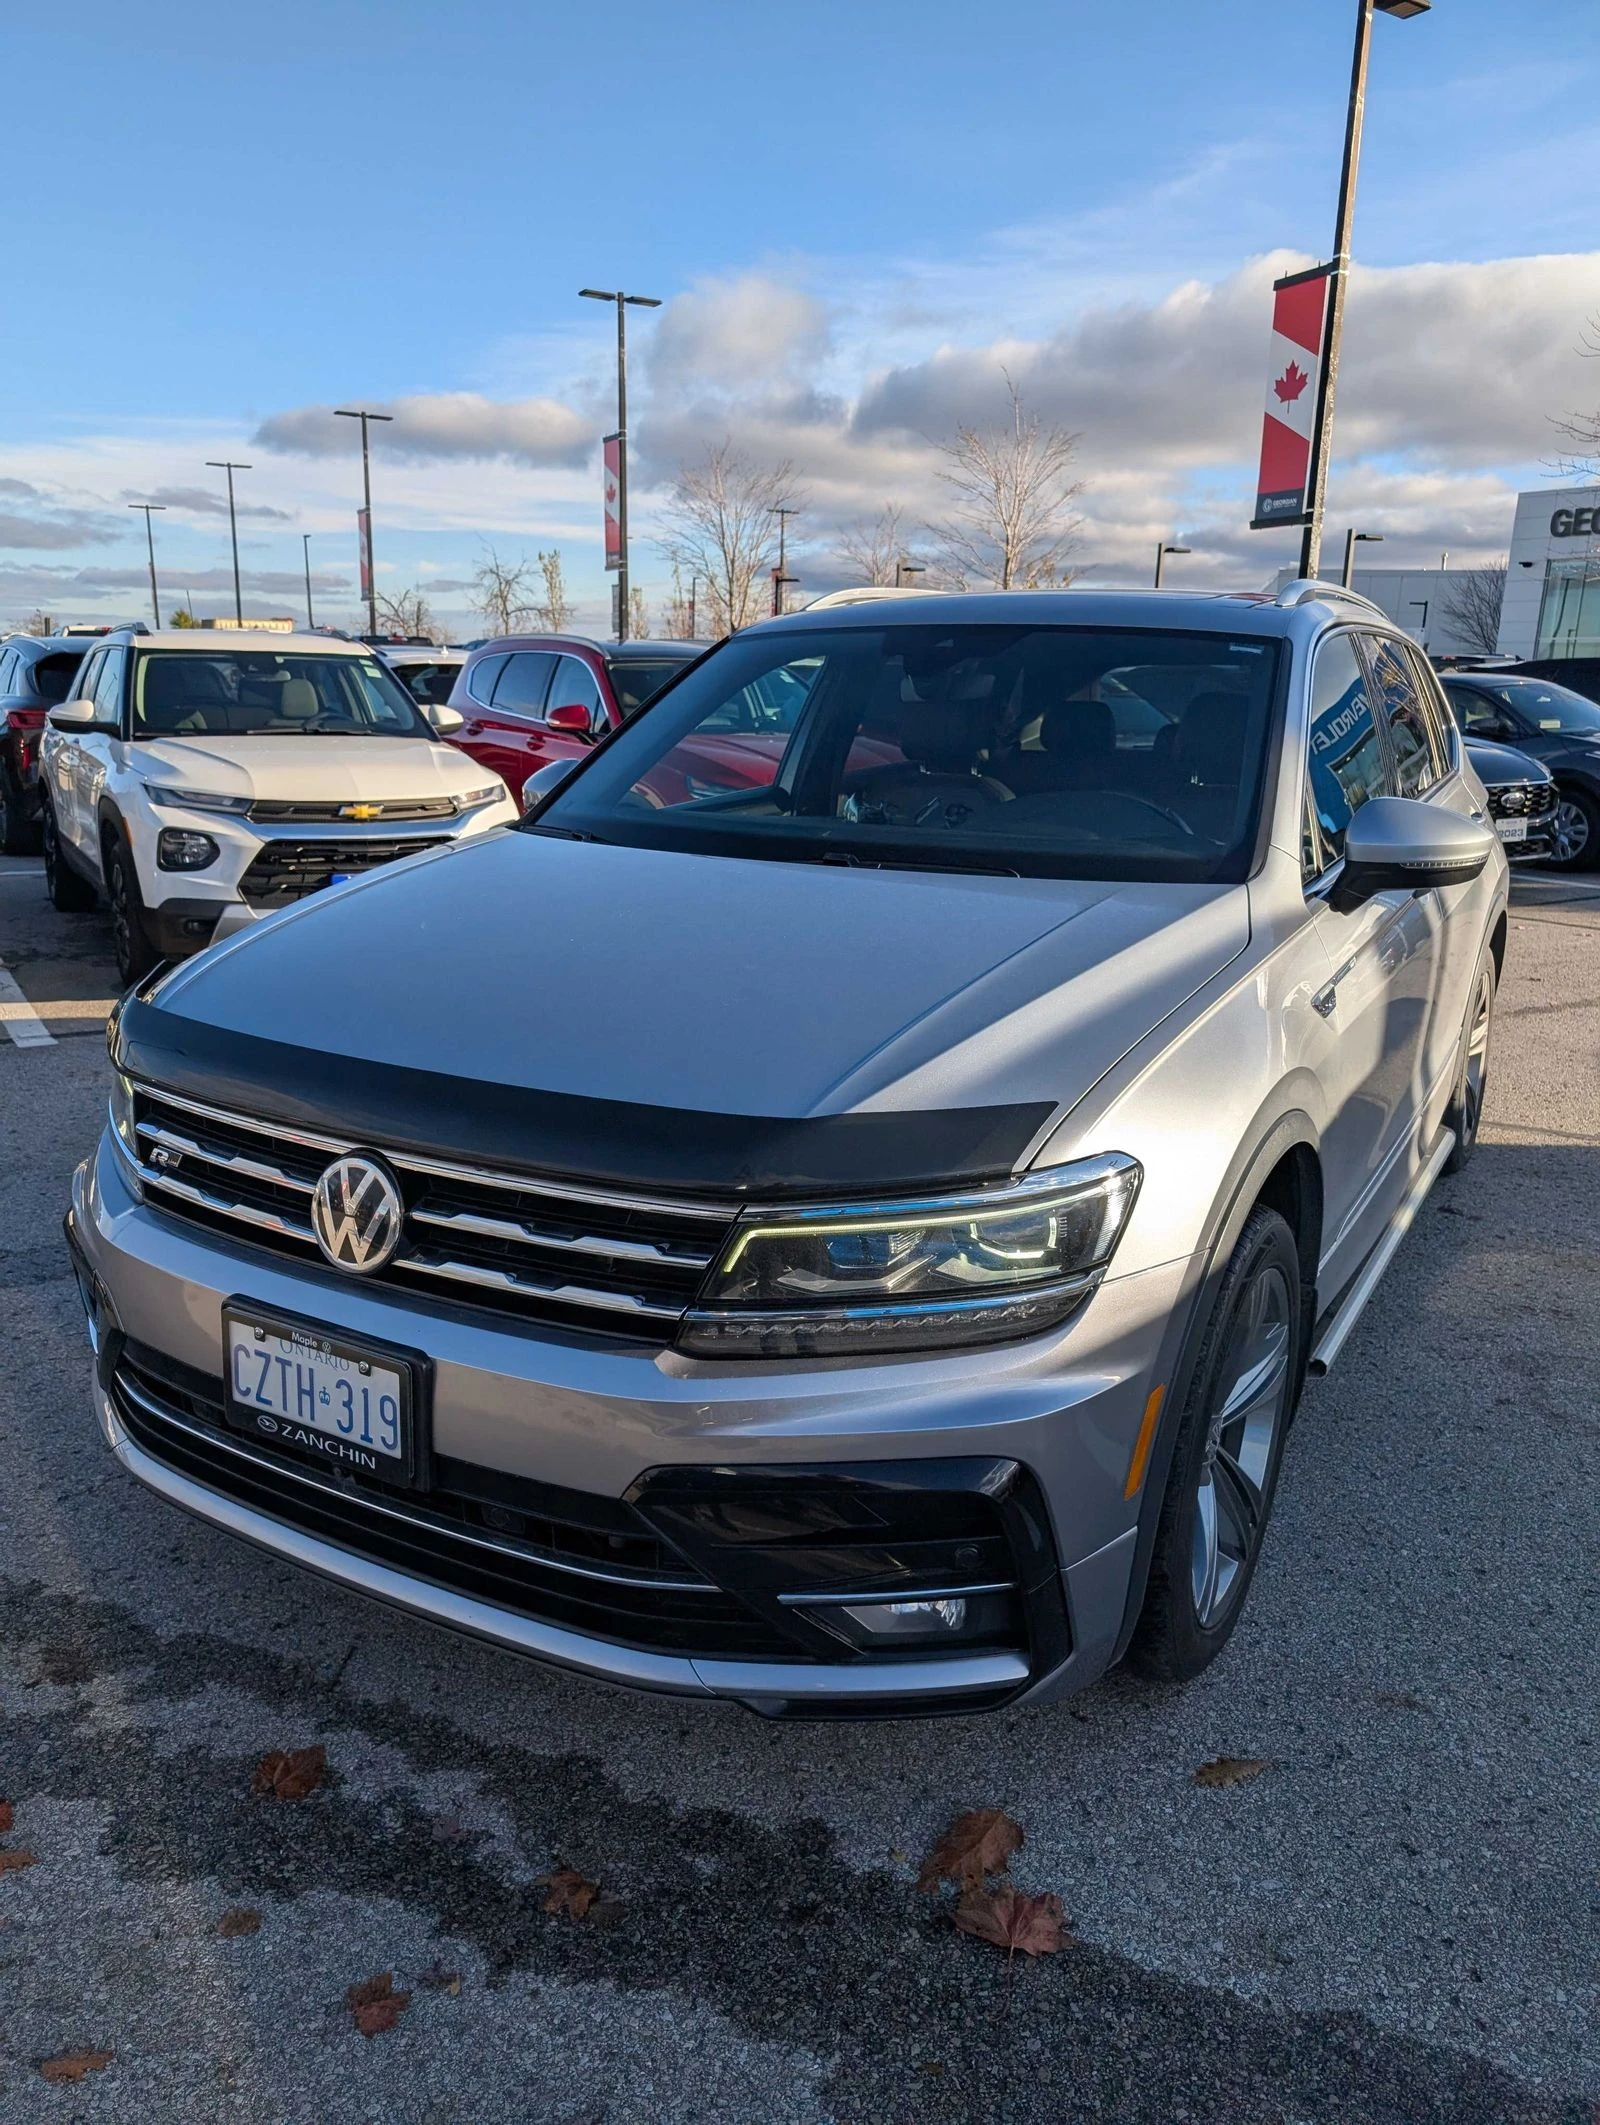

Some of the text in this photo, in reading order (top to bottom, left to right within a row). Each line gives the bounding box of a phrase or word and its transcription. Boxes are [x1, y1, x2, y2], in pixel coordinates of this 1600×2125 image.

[280, 1339, 350, 1372] ONTARIO
[291, 1331, 318, 1348] Maple
[234, 1343, 398, 1450] CZTH 319
[281, 1423, 376, 1469] ZANCHIN
